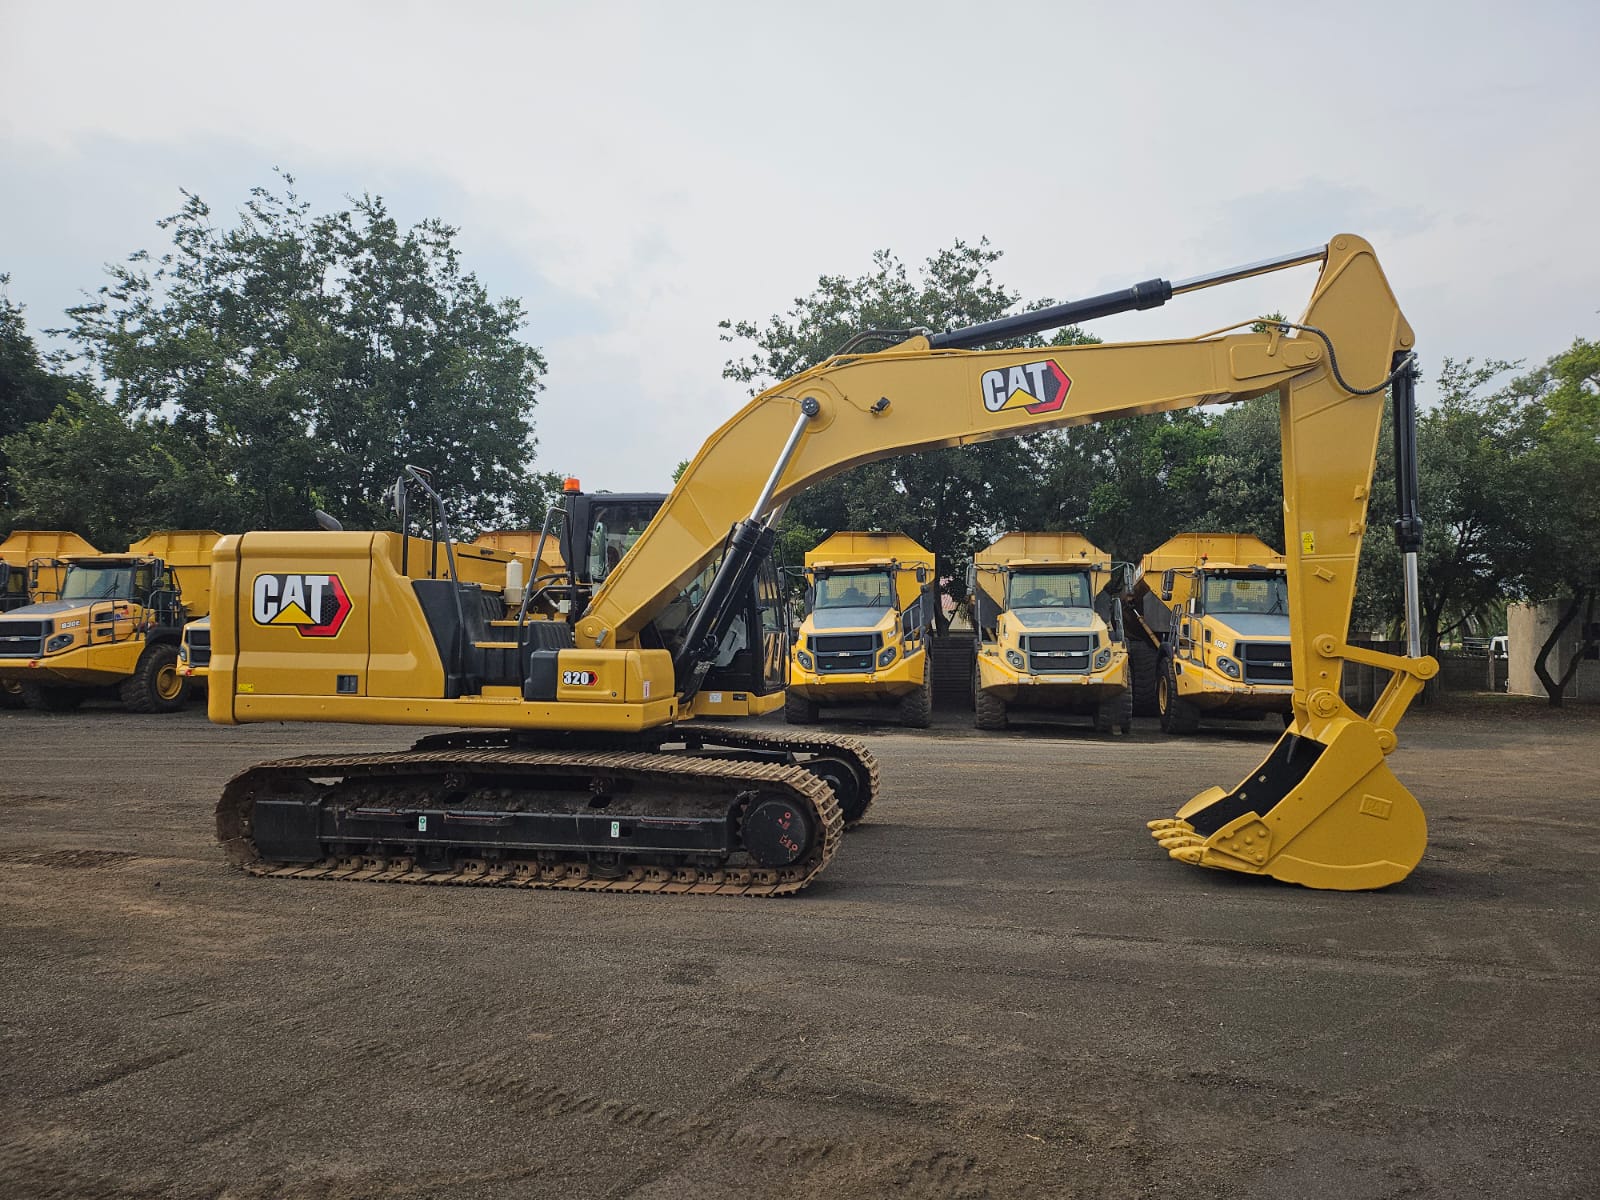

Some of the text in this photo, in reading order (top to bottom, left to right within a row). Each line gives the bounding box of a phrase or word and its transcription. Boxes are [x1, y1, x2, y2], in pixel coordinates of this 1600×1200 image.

[982, 361, 1048, 411] CAT
[253, 574, 330, 624] CAT
[563, 671, 589, 685] 320
